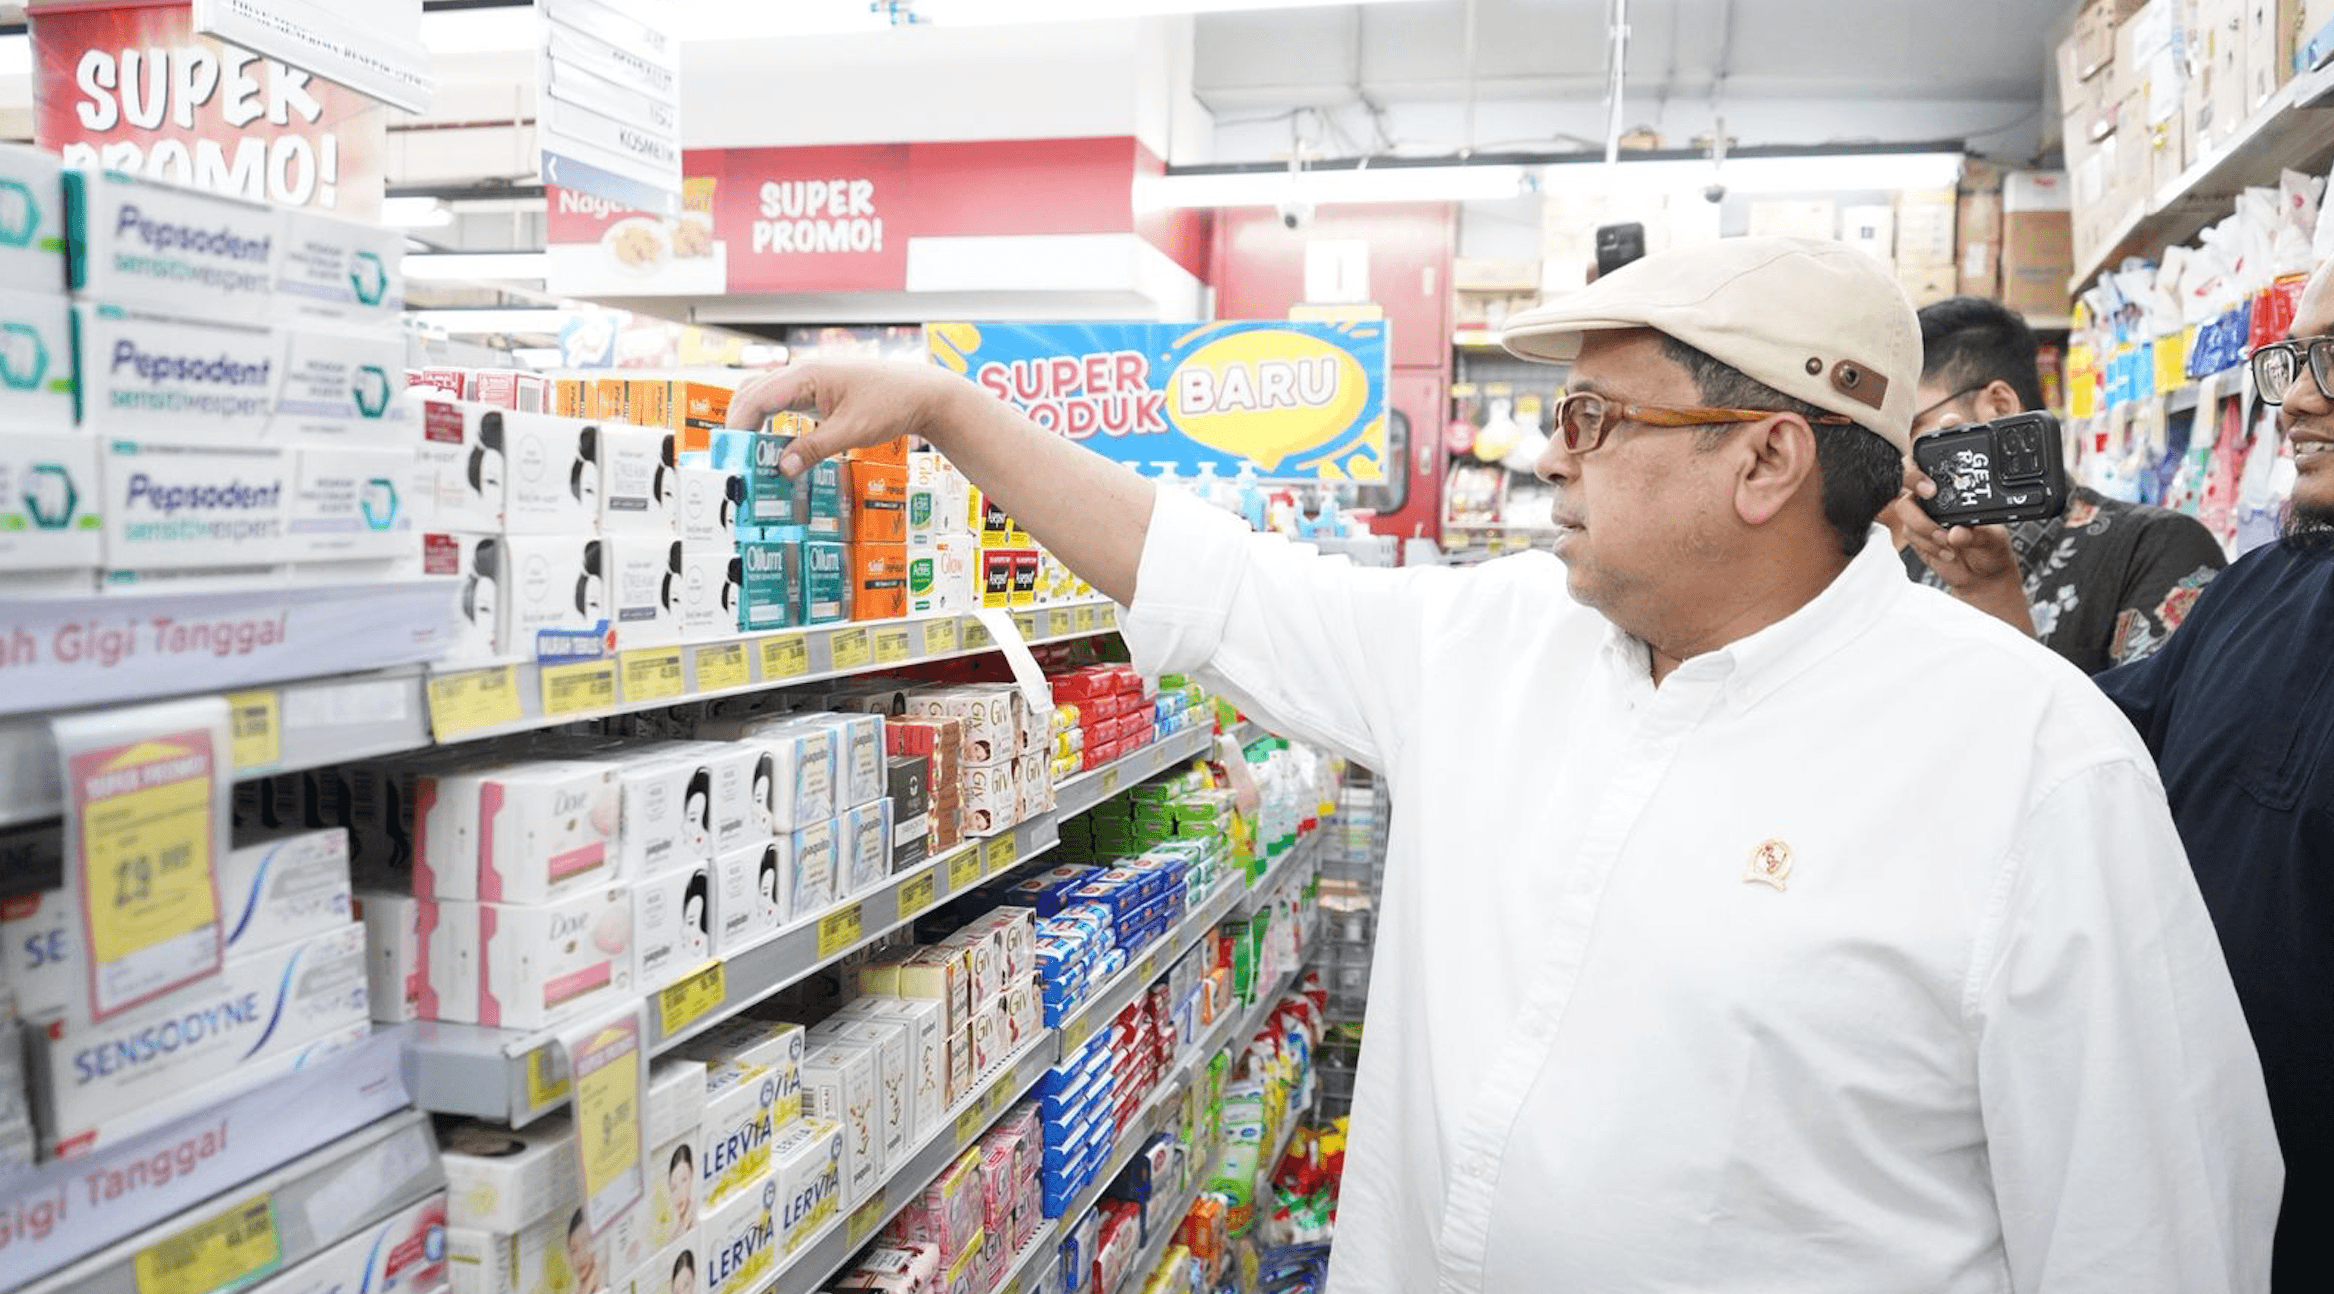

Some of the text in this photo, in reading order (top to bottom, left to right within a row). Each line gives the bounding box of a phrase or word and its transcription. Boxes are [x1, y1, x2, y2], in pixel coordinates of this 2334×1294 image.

[76, 47, 323, 131] SUPER
[761, 178, 875, 218] SUPER
[117, 203, 271, 264] Pepsodent
[753, 218, 883, 253] PROMO!
[110, 337, 271, 386] Pepsodent
[978, 352, 1150, 402] SUPER
[1179, 356, 1339, 416] BARU
[126, 472, 282, 518] Pepsodent
[1972, 452, 1993, 500] GET
[746, 545, 783, 572] Oilum
[810, 547, 840, 571] Oilum
[53, 618, 138, 668] Gigi
[151, 608, 291, 657] Tanggal
[553, 789, 589, 817] Dove
[549, 912, 590, 942] Dove
[73, 992, 260, 1084] SENSODYNE
[87, 1117, 229, 1205] Tanggal
[703, 1114, 773, 1181] LERVIA
[783, 1166, 840, 1231] LERVIA
[709, 1215, 774, 1288] LERVIA
